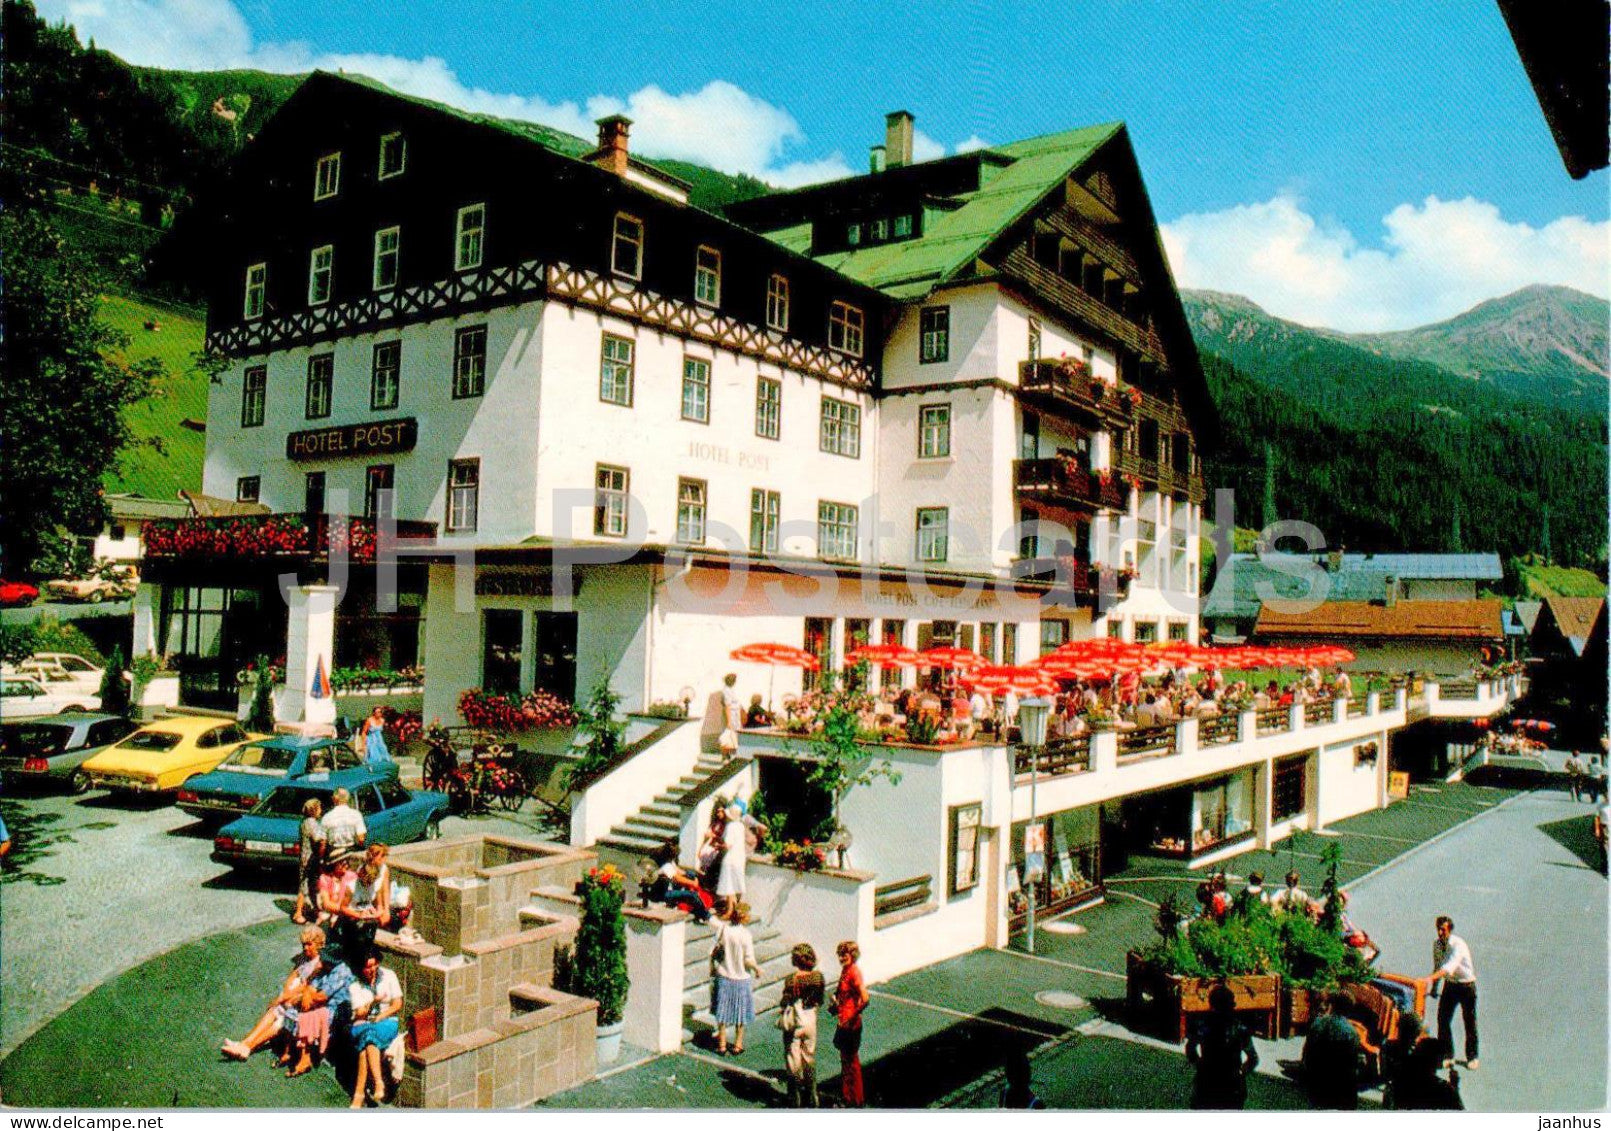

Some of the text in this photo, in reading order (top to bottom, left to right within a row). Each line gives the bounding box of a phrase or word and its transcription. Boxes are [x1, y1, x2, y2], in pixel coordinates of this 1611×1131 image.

[294, 423, 406, 454] HOTEL POST
[689, 441, 771, 472] HOTEL POST
